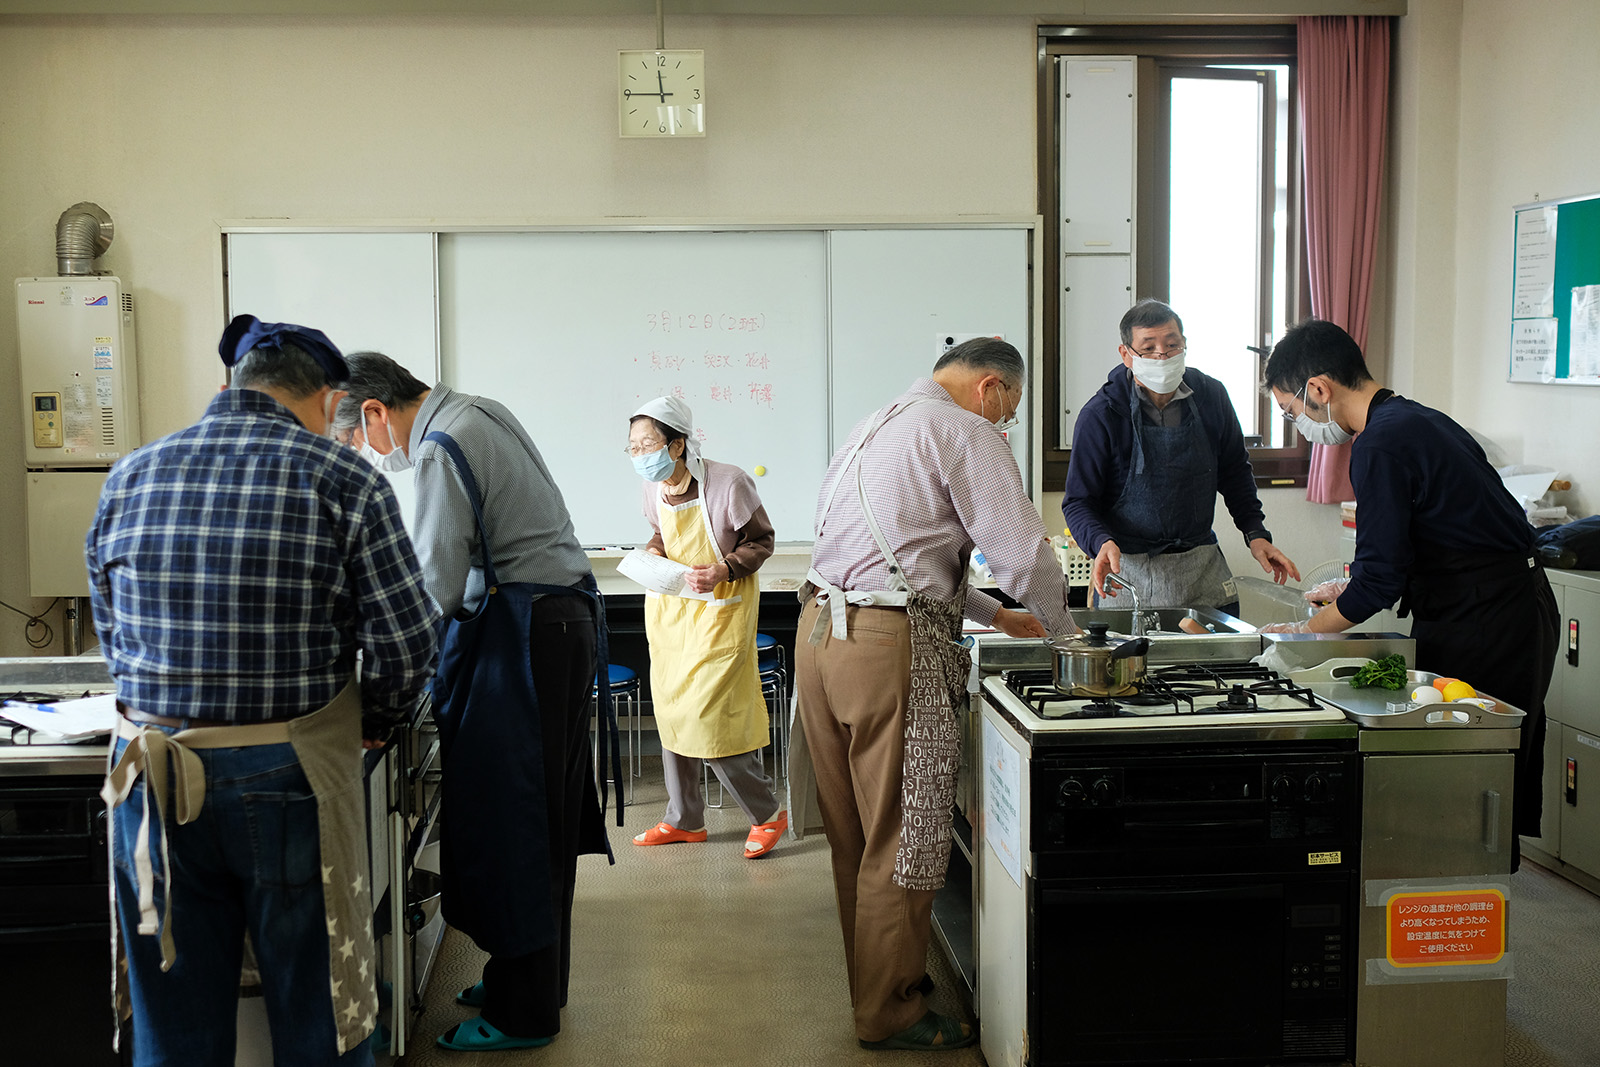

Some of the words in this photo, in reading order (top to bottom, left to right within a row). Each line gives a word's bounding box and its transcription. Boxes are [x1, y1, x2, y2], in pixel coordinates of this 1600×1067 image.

[657, 56, 666, 66] 12
[624, 89, 632, 100] 9
[693, 89, 701, 99] 3
[659, 122, 666, 133] 6
[912, 677, 938, 688] OUSE
[1398, 902, 1494, 914] レンジの温度が他の調理台
[1400, 917, 1491, 928] より高くなってしまうため、
[1406, 929, 1486, 941] 設定温度に気をつけて
[1419, 944, 1474, 954] ご使用ください
